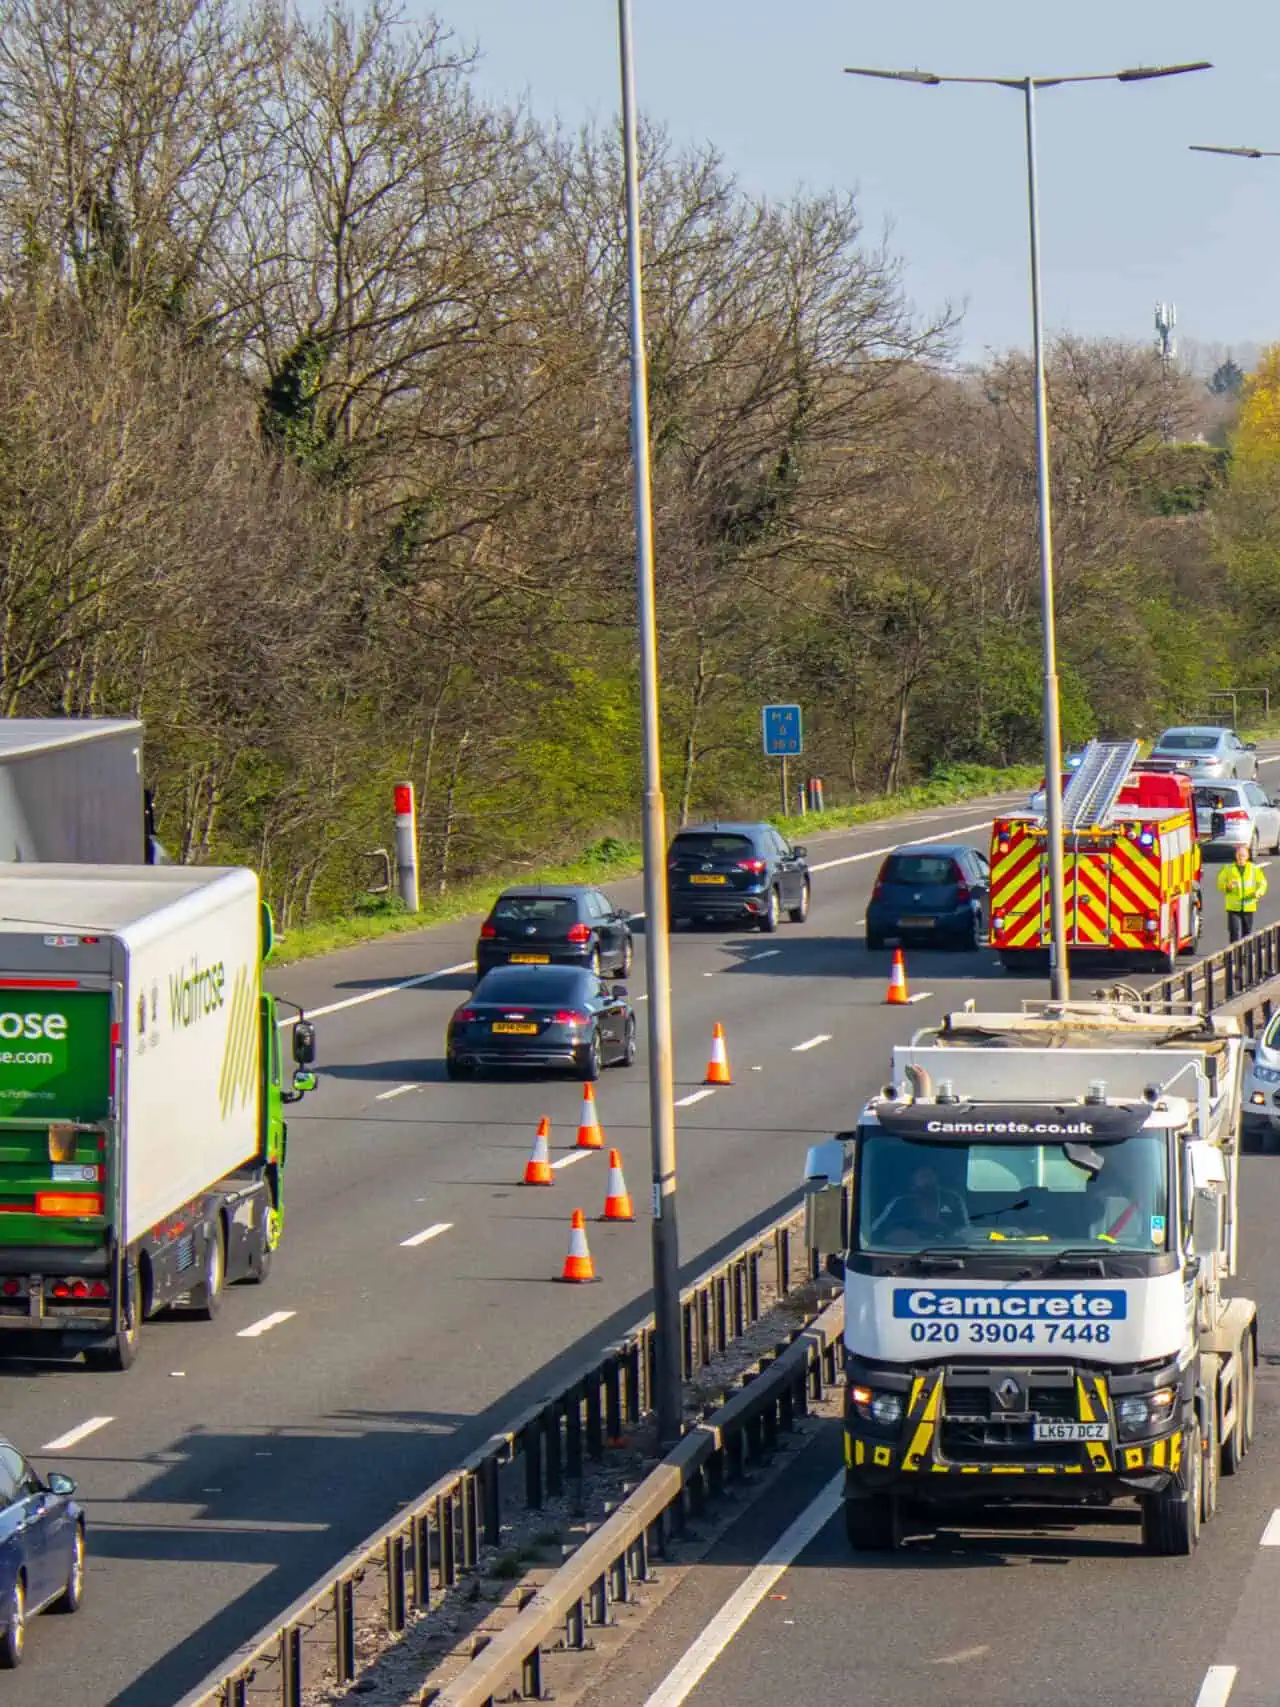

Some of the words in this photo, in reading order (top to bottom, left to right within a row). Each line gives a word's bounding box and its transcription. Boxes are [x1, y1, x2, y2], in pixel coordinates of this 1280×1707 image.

[168, 953, 224, 1032] Waitrose
[0, 1012, 68, 1039] ose
[0, 1051, 53, 1064] e.com
[927, 1120, 1093, 1135] Camcrete.co.uk
[908, 1291, 1114, 1316] Camcrete
[910, 1322, 959, 1343] 020
[969, 1322, 1036, 1343] 3904
[1044, 1322, 1111, 1343] 7448
[1039, 1425, 1075, 1438] LK67
[1078, 1425, 1105, 1438] DCZ
